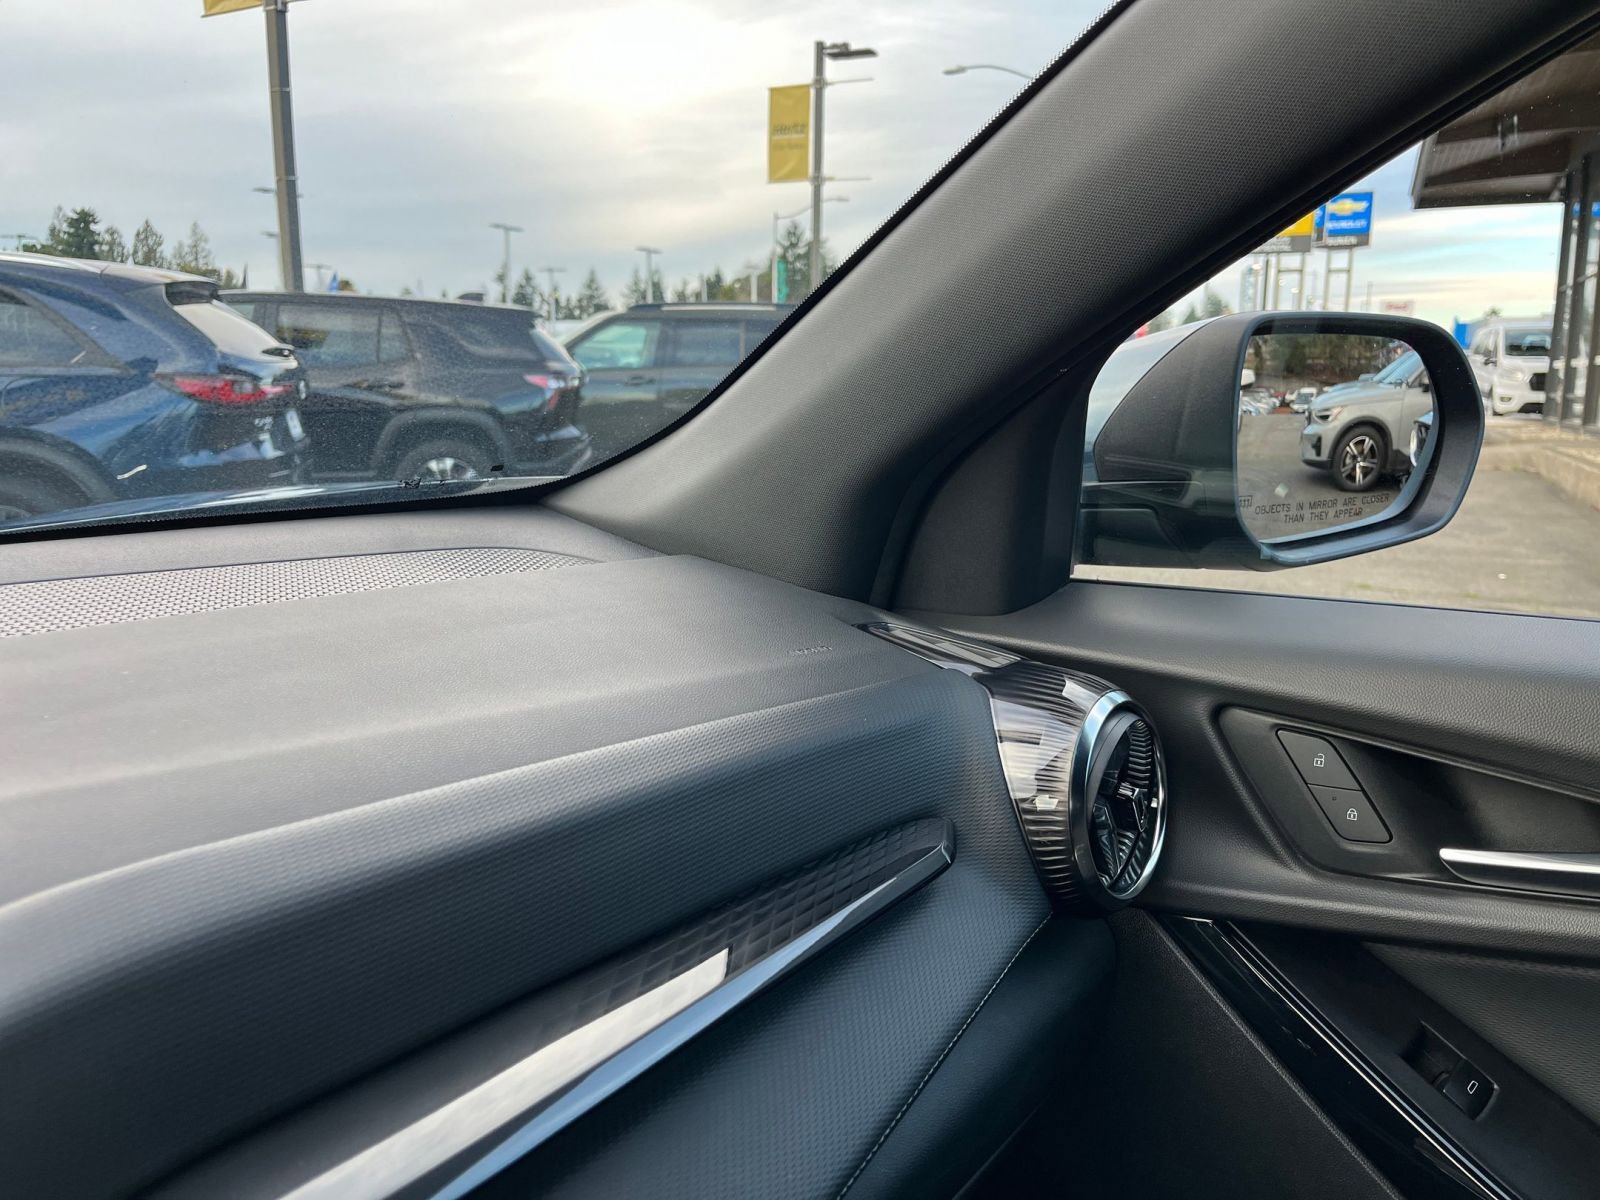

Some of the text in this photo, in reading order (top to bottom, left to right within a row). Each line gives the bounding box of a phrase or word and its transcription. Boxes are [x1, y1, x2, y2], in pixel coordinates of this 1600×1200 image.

[1254, 493, 1390, 515] OBJECTS IN MIRROR ARE CLOSER
[1283, 507, 1364, 524] THAN THEY APPEAR
